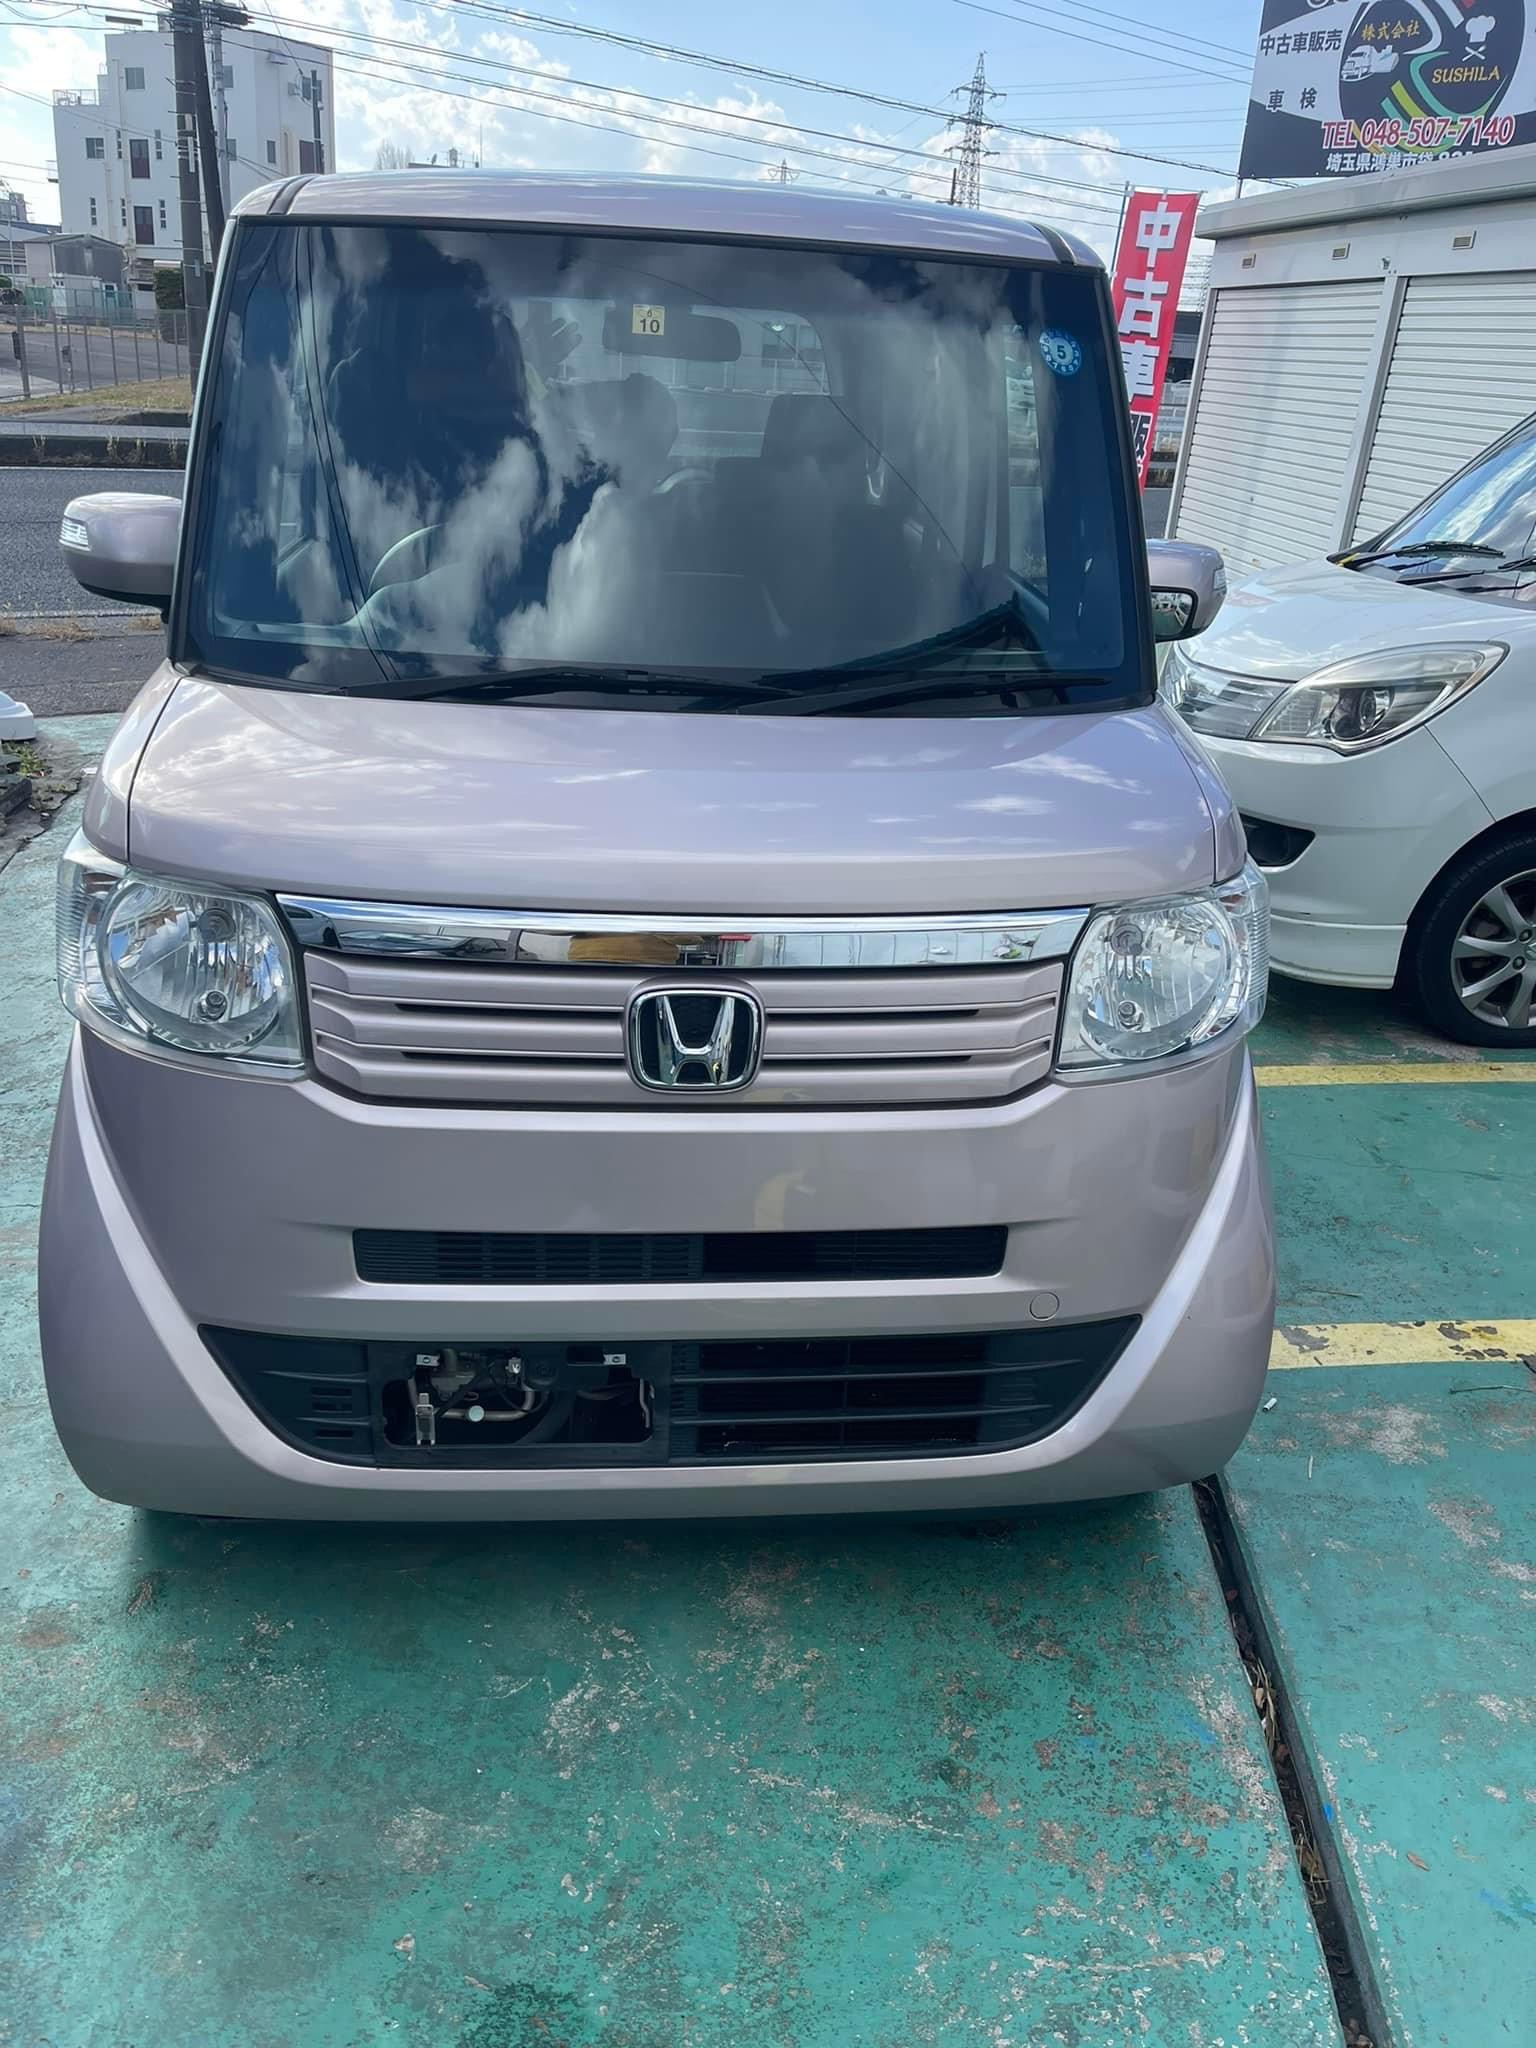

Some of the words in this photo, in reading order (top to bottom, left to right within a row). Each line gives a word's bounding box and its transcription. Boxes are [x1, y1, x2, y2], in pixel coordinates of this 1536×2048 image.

[1361, 20, 1420, 40] 株式会社
[1260, 29, 1341, 55] 中古車販売
[1432, 66, 1500, 84] SUSHILA
[1361, 115, 1516, 147] 048-507-7140
[640, 318, 660, 333] 10
[1057, 345, 1066, 360] 5
